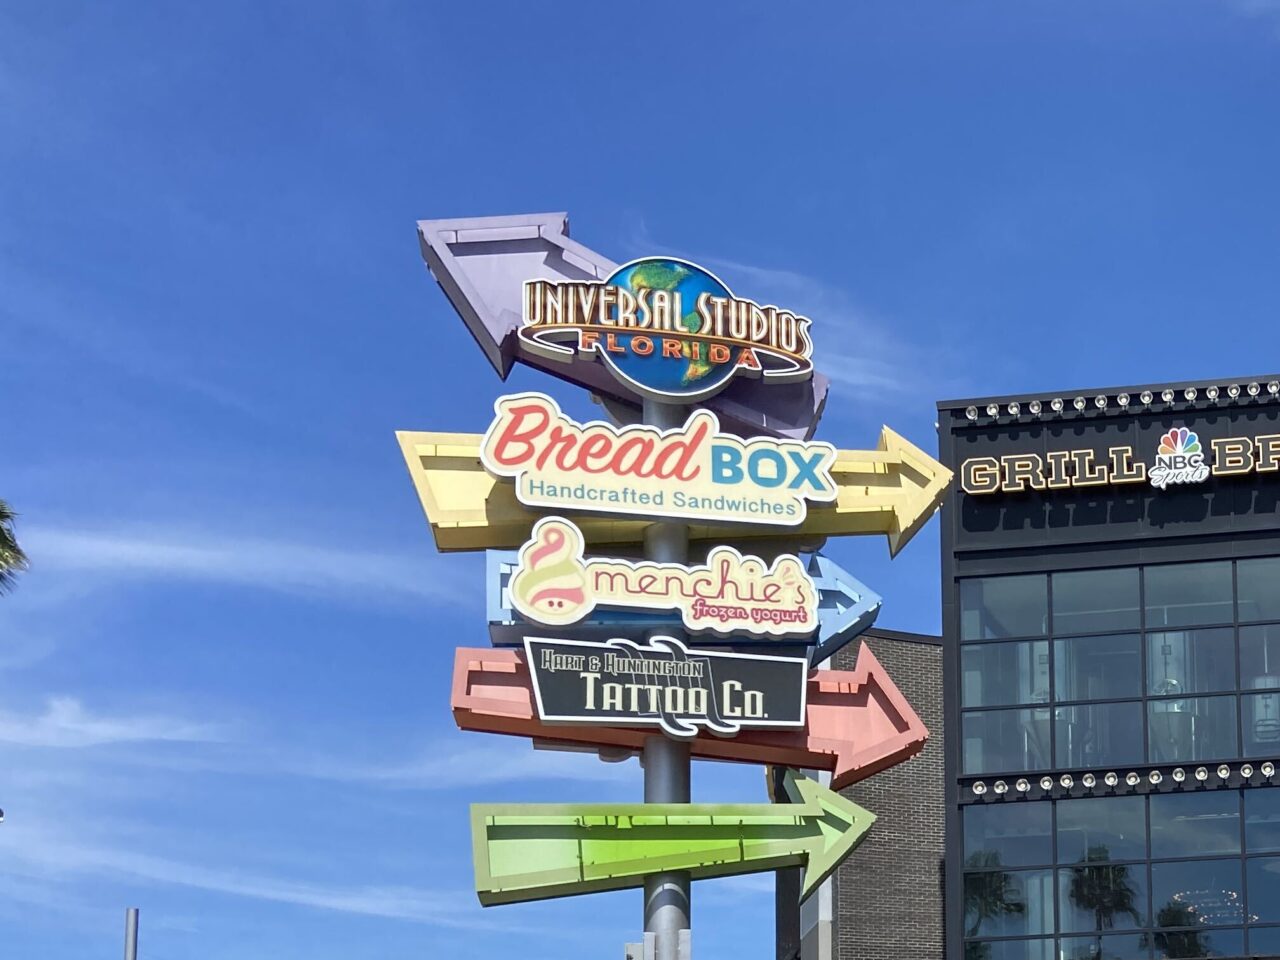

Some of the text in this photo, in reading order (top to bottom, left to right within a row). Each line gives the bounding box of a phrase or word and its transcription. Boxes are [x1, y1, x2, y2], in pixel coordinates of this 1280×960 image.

[523, 280, 811, 355] UNIVERSAL STUDIOS
[579, 331, 761, 370] FLORIDA
[492, 405, 829, 491] Bread BOX
[1157, 454, 1203, 471] NBC
[961, 446, 1145, 494] GRILL
[1149, 464, 1208, 486] Sports
[529, 479, 796, 515] Handcrafted Sandwiches
[595, 560, 806, 604] menchie's
[692, 598, 807, 625] frozen yogurt
[541, 649, 704, 678] HART & HUNTINGTON
[580, 672, 708, 715] TATTOO
